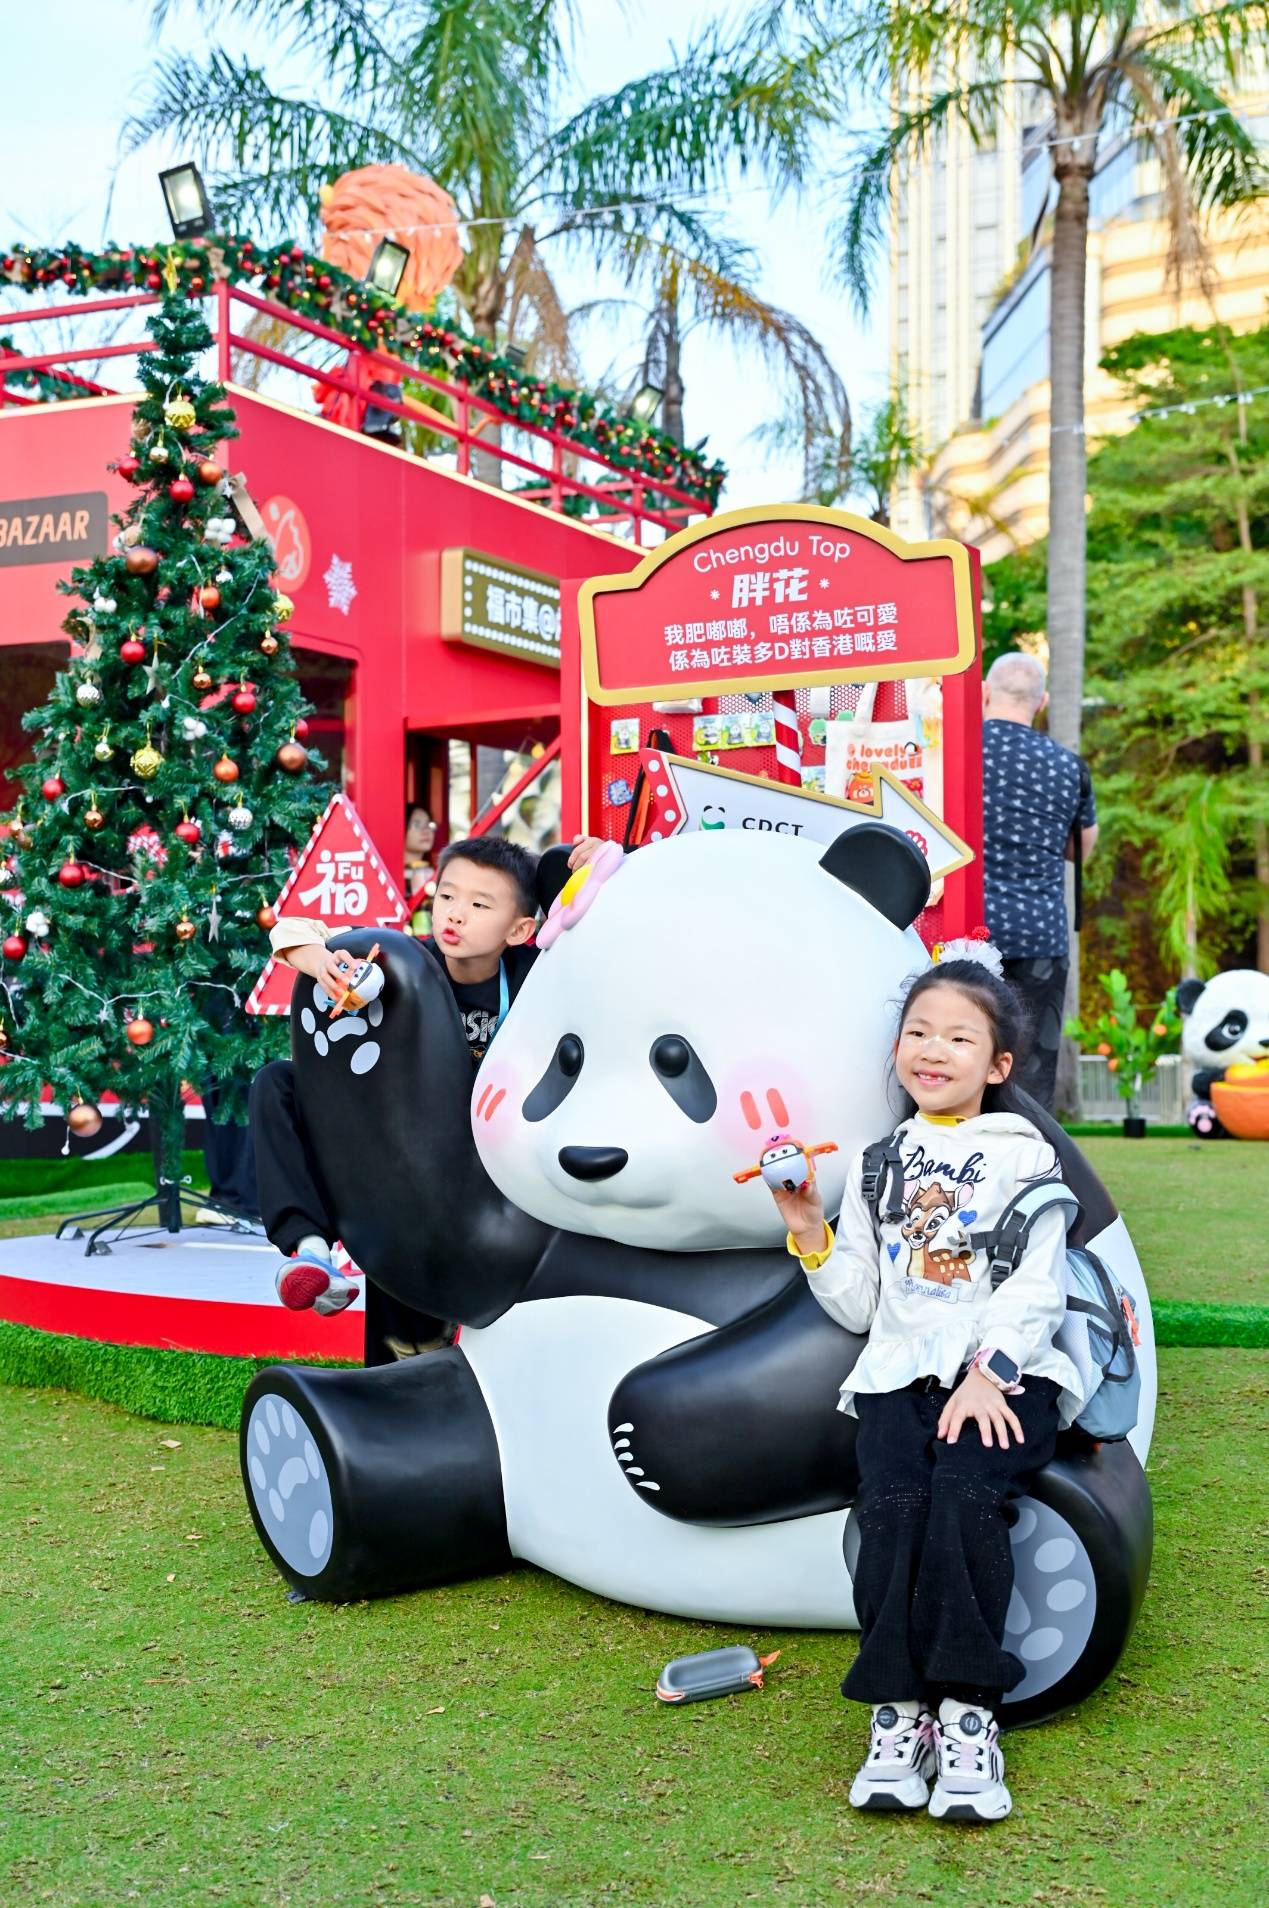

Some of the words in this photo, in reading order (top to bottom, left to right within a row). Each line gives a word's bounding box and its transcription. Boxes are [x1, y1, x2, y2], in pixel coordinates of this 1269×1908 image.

[693, 536, 799, 573] Chengdu
[808, 535, 851, 563] Top
[731, 567, 809, 609] 胖花
[337, 862, 364, 880] Fu
[903, 1145, 986, 1184] Bambi
